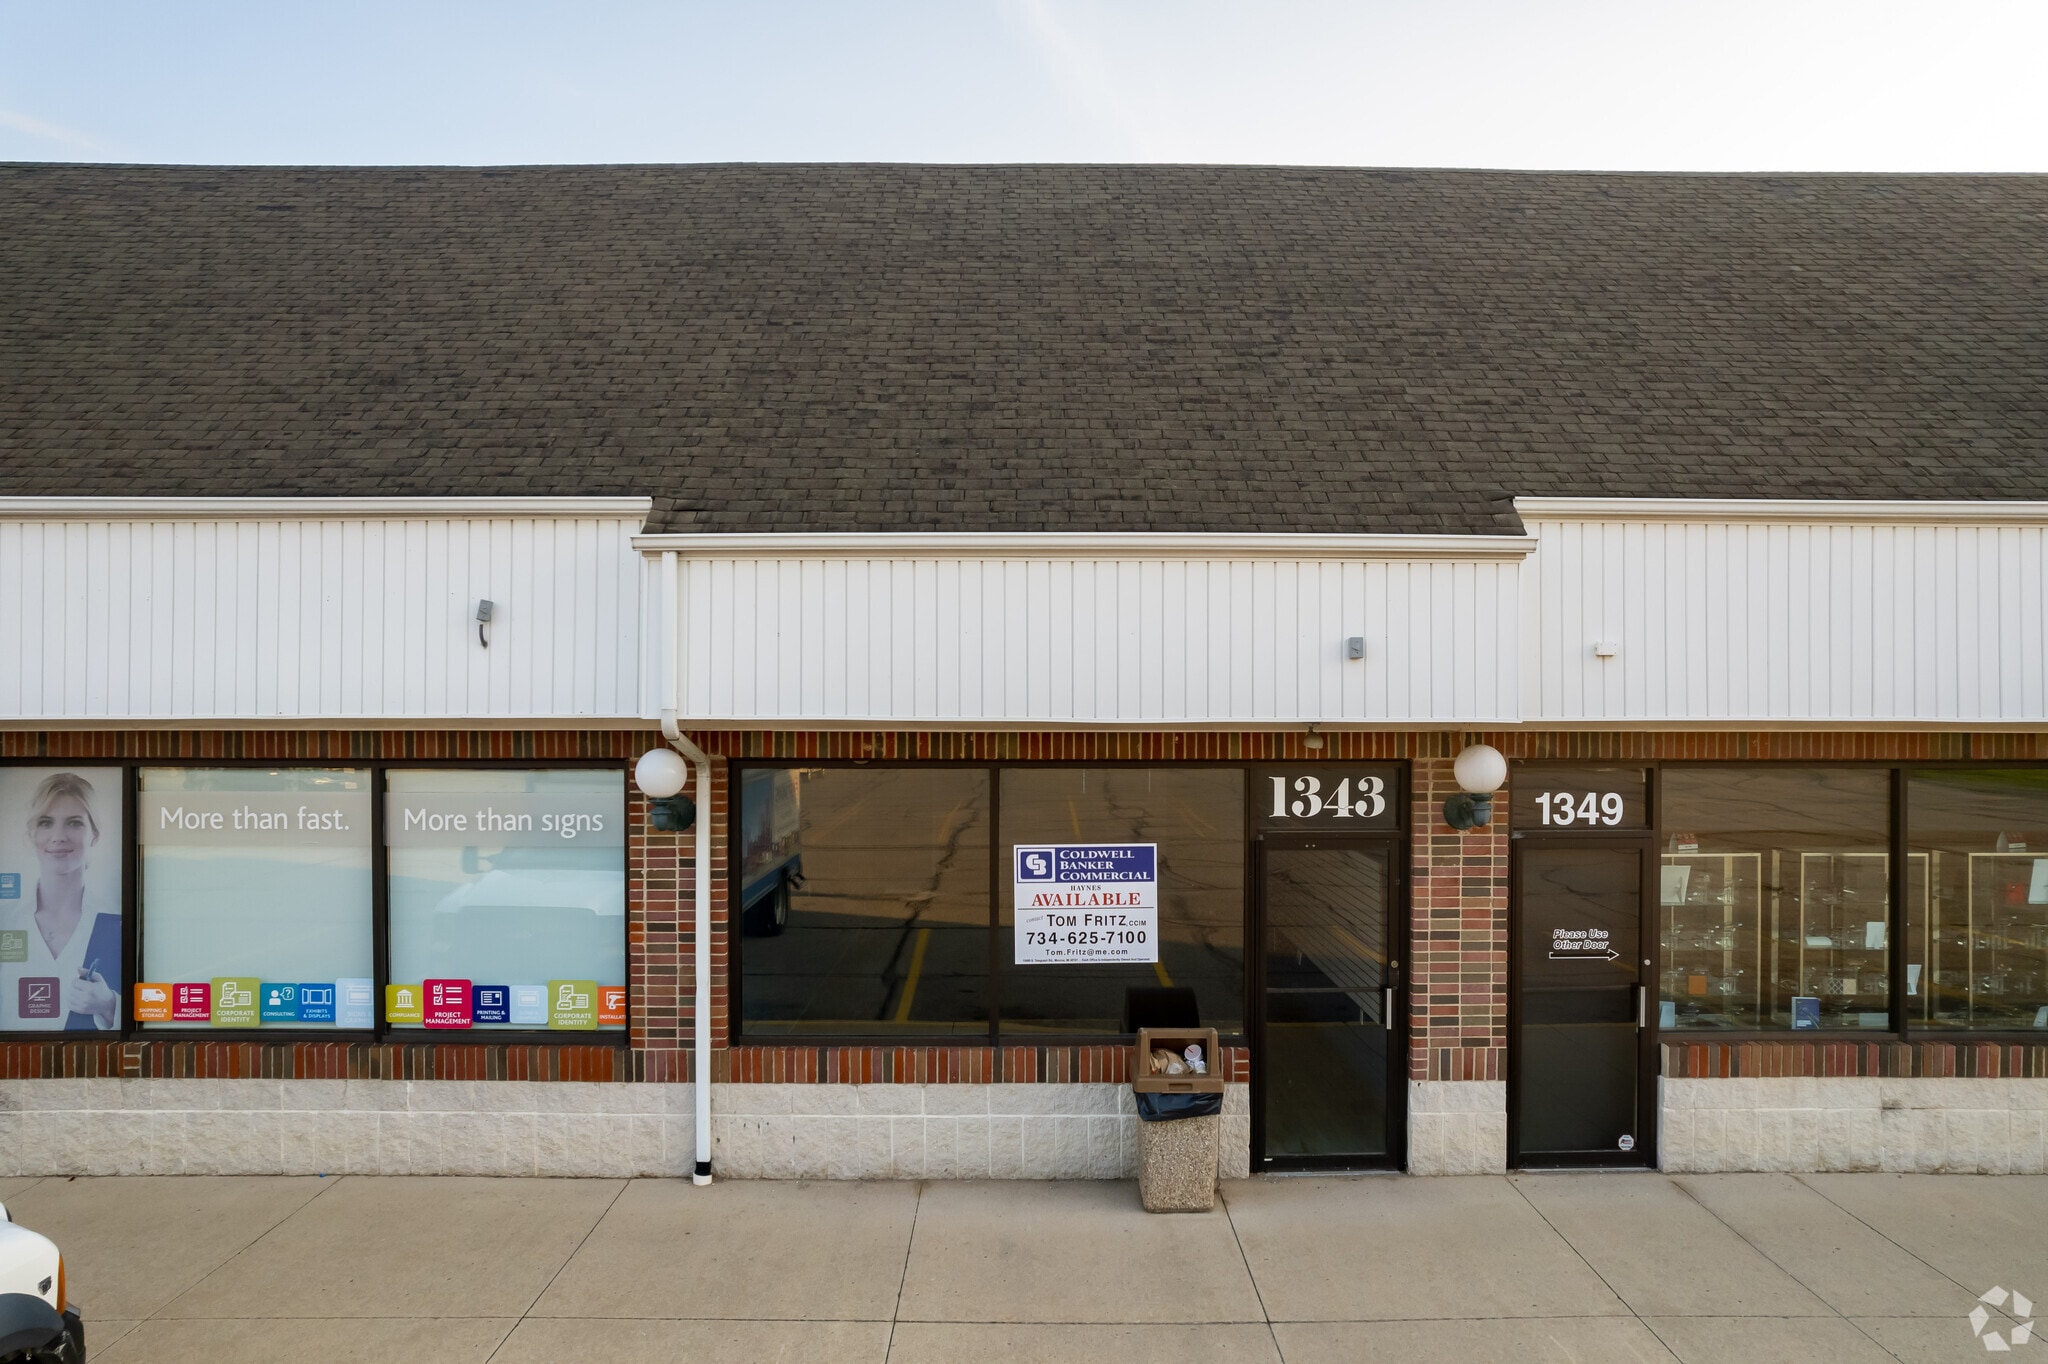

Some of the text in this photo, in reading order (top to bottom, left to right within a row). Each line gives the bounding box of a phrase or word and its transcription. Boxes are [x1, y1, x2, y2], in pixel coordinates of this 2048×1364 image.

[1268, 775, 1386, 818] 1343
[1534, 792, 1624, 826] 1349
[160, 806, 350, 831] More than fast.
[403, 807, 604, 839] More than signs
[1059, 849, 1135, 859] COLDWELL
[1060, 861, 1114, 870] BANKER
[1059, 871, 1151, 881] COMMERCIAL
[1070, 884, 1102, 892] HAYNES
[1031, 892, 1141, 907] AVAILABLE
[1046, 914, 1077, 927] TOM
[1026, 930, 1147, 945] 734-625-7100
[1552, 928, 1609, 940] Please Use
[1552, 939, 1610, 950] Other Door
[1045, 948, 1128, 957] Tom.Fritz@me.com
